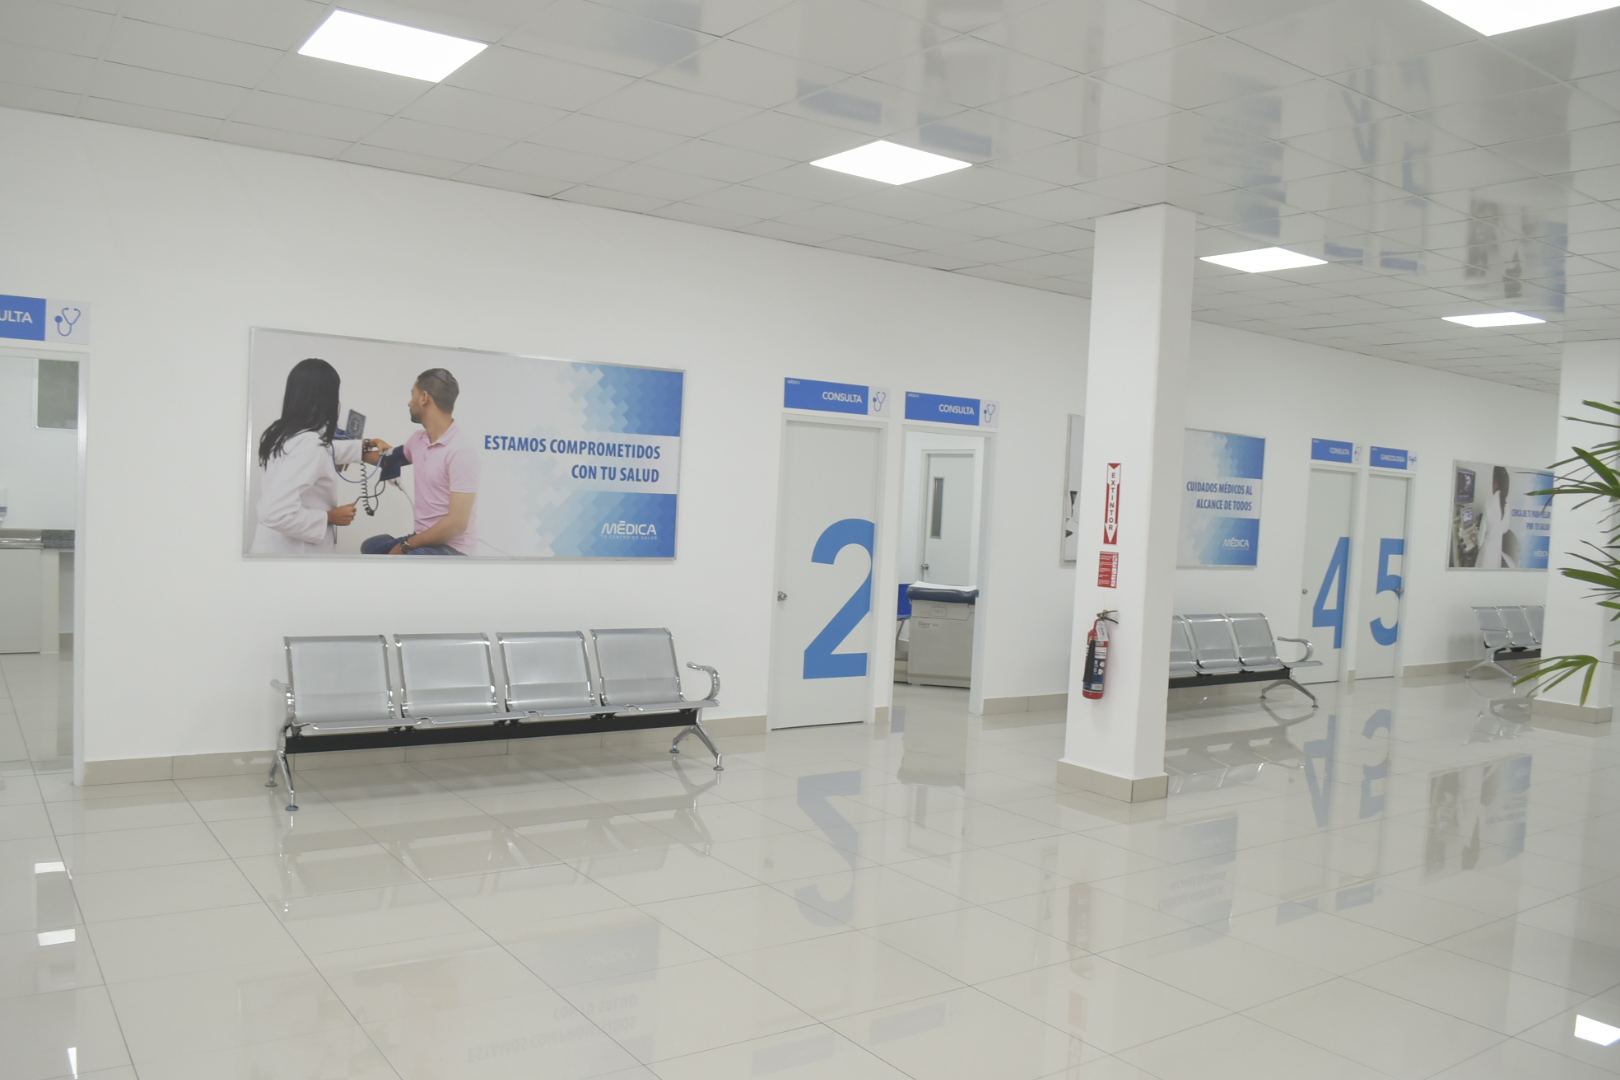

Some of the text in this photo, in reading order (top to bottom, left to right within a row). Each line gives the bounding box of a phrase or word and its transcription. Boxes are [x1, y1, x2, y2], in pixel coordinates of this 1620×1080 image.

[822, 391, 863, 404] CONSULTA
[938, 403, 974, 415] CONSULTA
[484, 435, 661, 460] ESTAMOS COMPROMETIDOS
[571, 464, 660, 483] CON TU SALUD
[1186, 481, 1253, 496] CUIDADOS MÉDICOS AL
[1108, 472, 1116, 531] EXTINTOR
[1196, 498, 1252, 511] ALCANCE DE TODOS
[803, 518, 875, 680] 2
[1312, 536, 1350, 649] 4
[1369, 537, 1405, 646] 5
